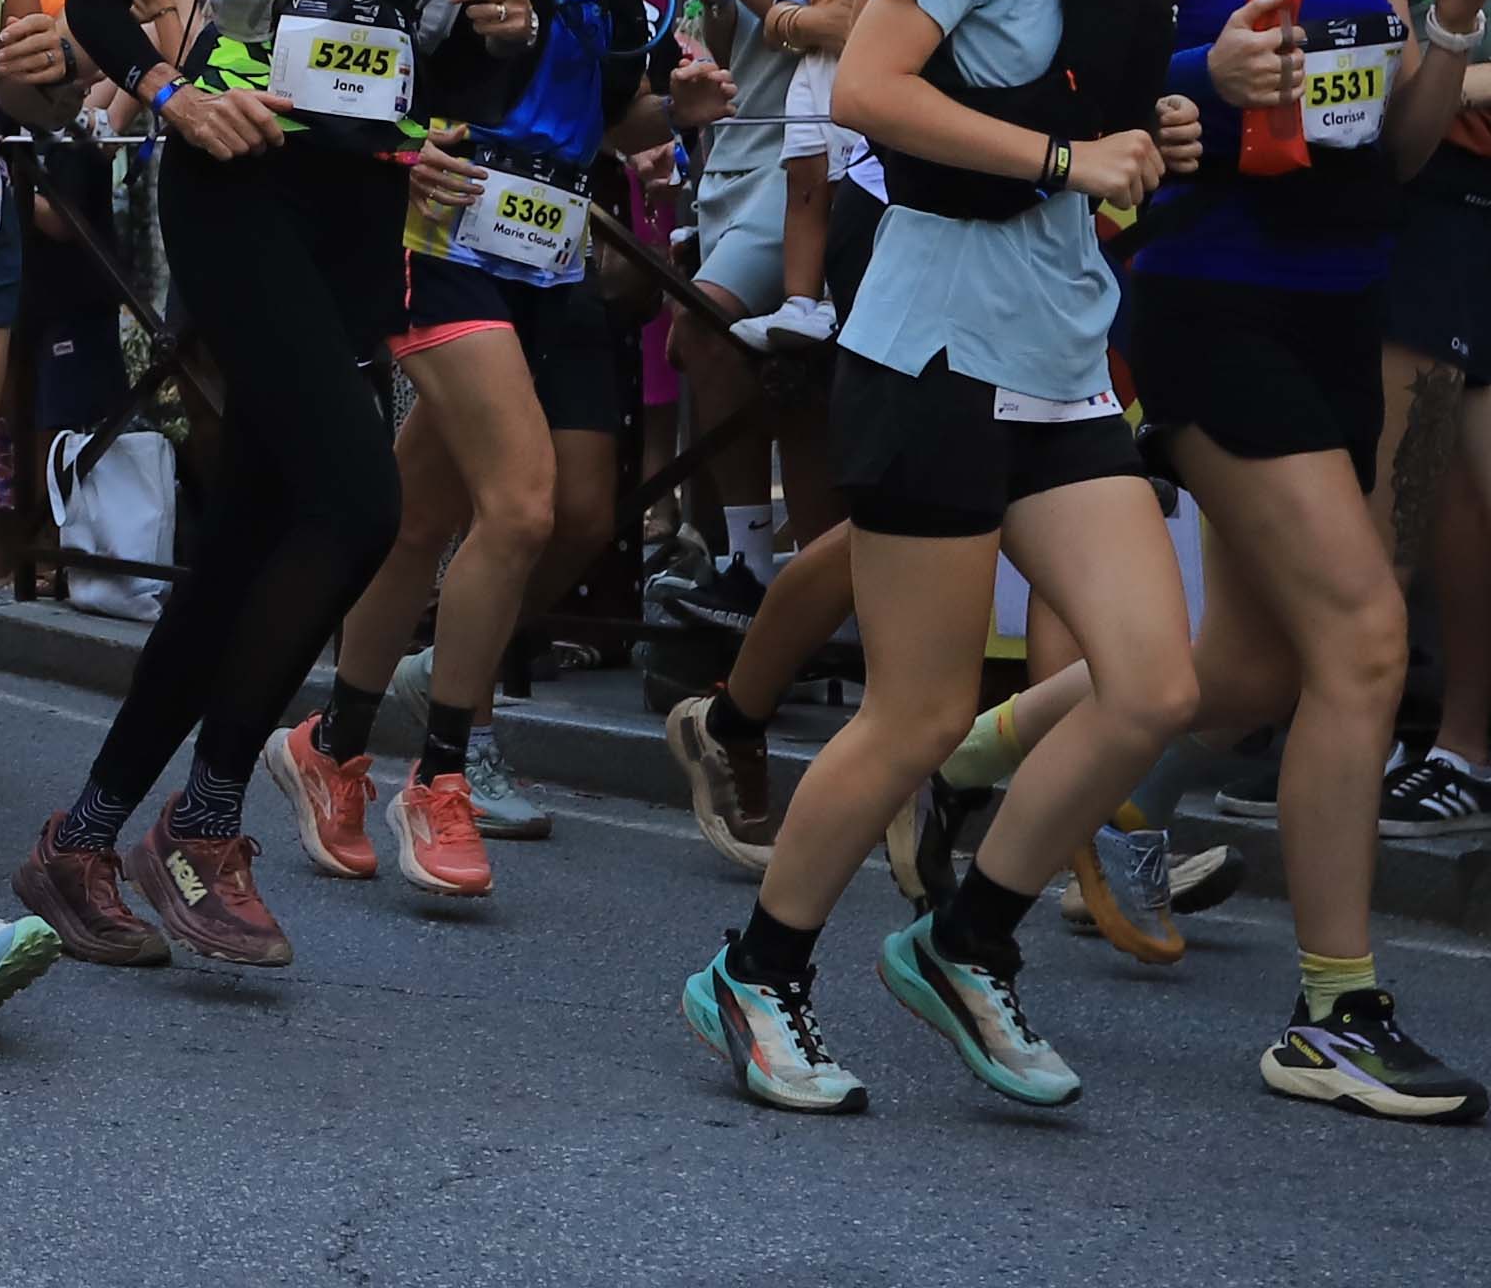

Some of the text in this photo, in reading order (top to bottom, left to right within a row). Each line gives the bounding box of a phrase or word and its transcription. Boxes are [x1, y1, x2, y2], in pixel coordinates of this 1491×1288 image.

[314, 42, 390, 77] 5245
[332, 78, 365, 94] Jane
[1311, 69, 1375, 106] 5531
[1322, 110, 1367, 127] Clarisse
[501, 193, 563, 231] 5369
[493, 221, 558, 250] Marie Claude
[165, 849, 209, 907] HOKA
